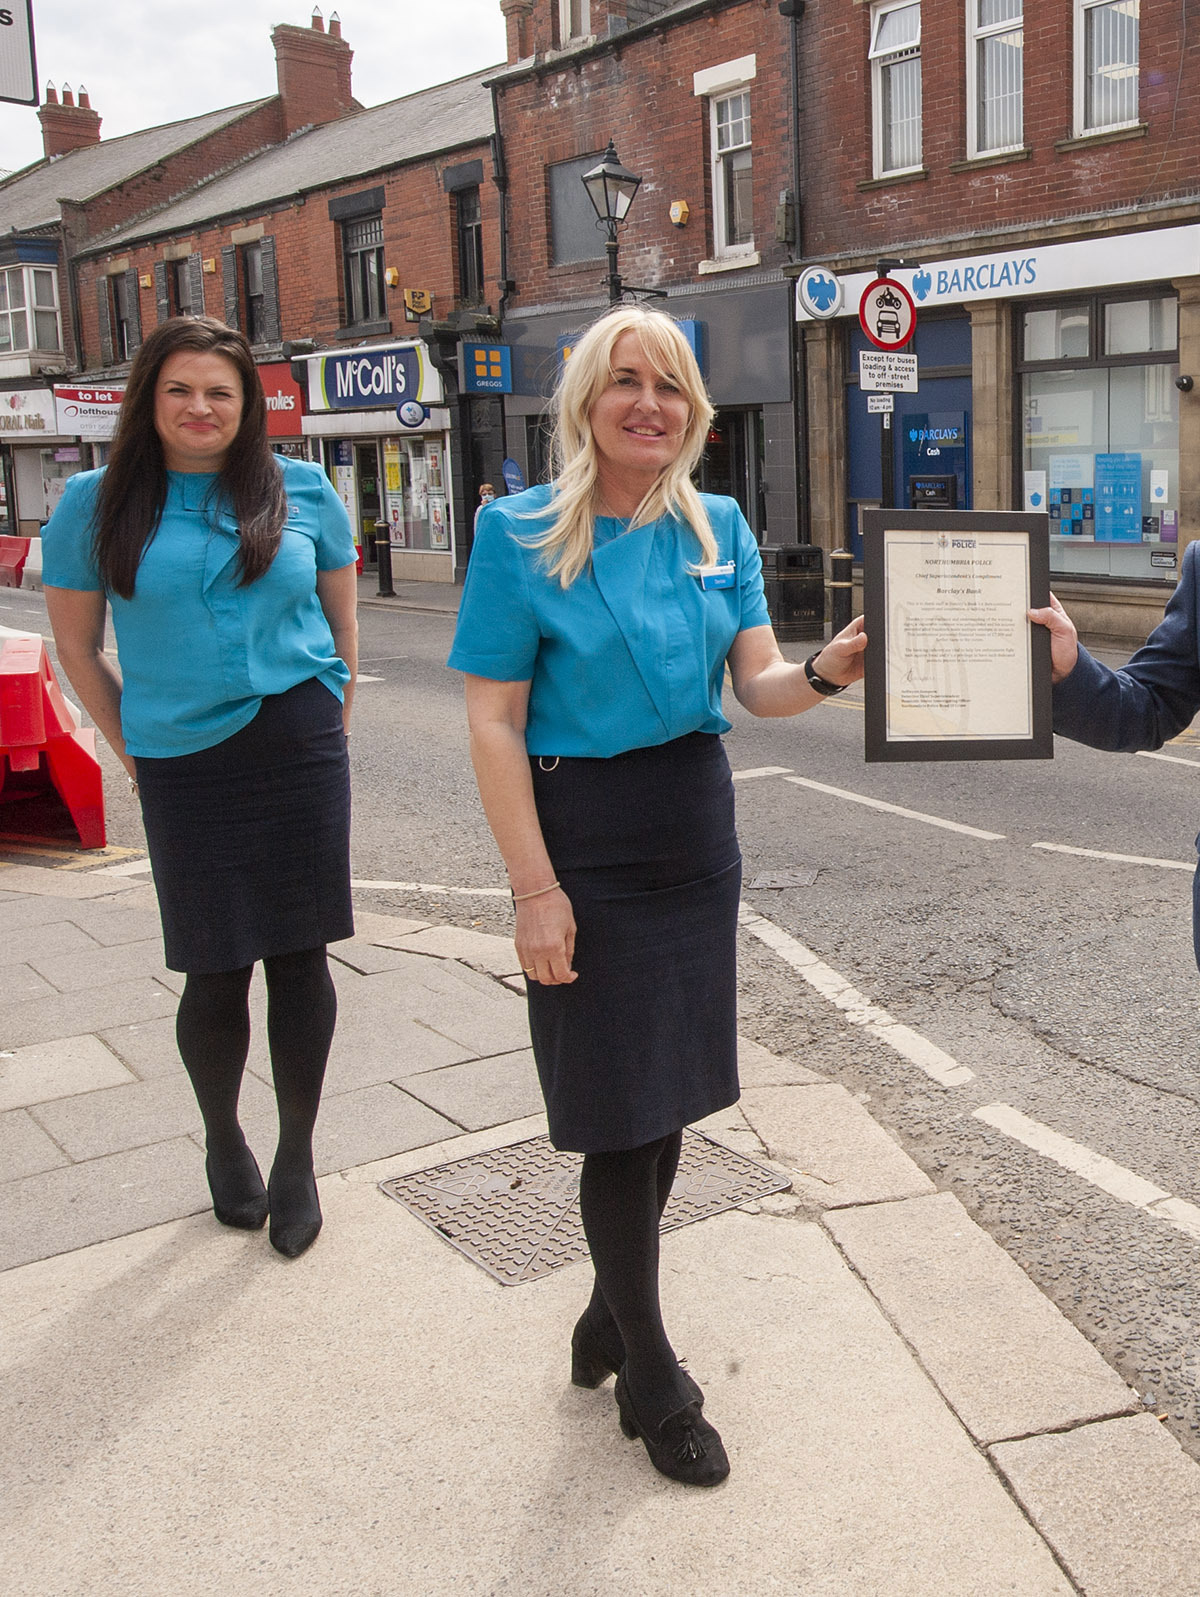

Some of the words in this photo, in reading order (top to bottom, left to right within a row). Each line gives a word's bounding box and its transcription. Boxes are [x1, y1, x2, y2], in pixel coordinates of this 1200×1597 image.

[936, 258, 1037, 295] BARCLAYS
[862, 354, 885, 363] Except
[886, 355, 896, 363] for
[897, 356, 915, 364] buses
[863, 363, 887, 371] loading
[894, 365, 915, 373] access
[335, 355, 406, 398] McColl's
[476, 380, 503, 388] GREGGS
[78, 391, 92, 401] to
[95, 391, 113, 401] let
[265, 389, 295, 411] rokes
[79, 407, 121, 416] lofthous
[0, 415, 23, 431] ORAL
[918, 428, 958, 441] BARCLAYS
[926, 447, 941, 456] Cash
